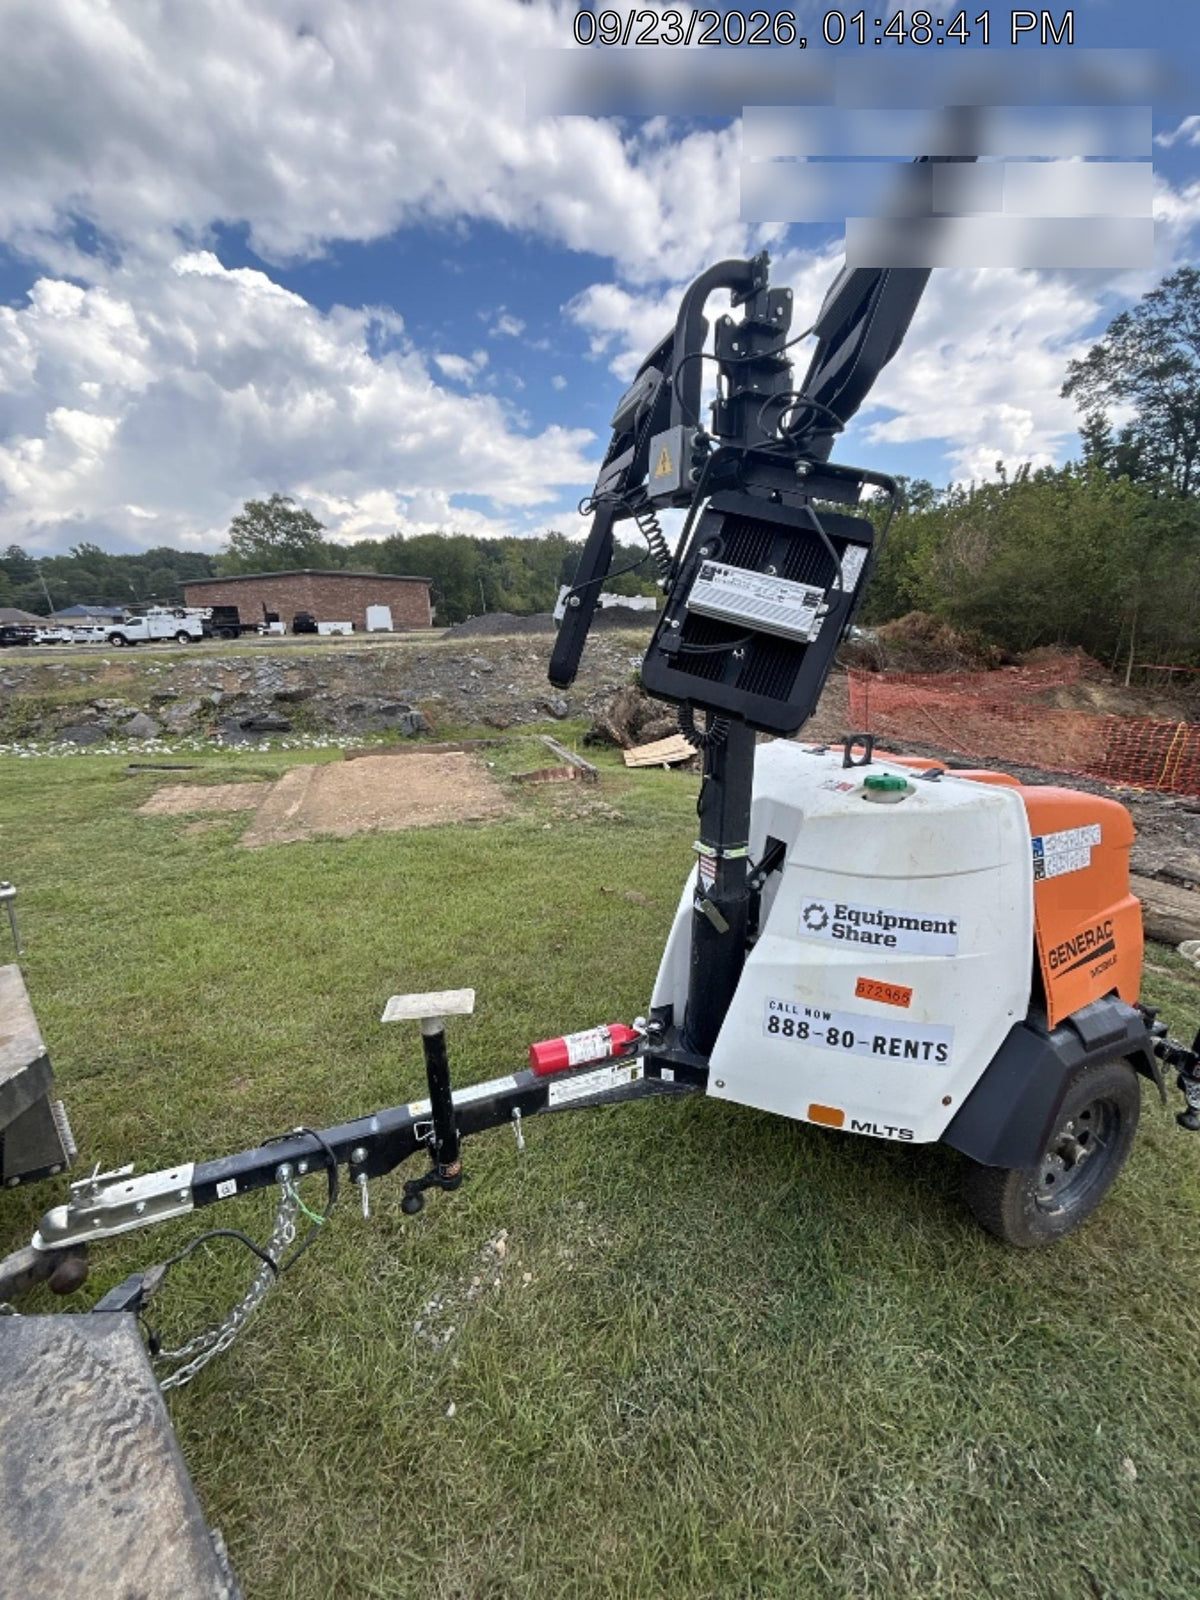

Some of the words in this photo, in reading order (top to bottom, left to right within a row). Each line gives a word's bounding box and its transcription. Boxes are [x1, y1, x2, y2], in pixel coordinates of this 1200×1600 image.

[834, 904, 957, 935] Equipment
[832, 924, 897, 947] Share
[1049, 920, 1113, 970] GENERAC
[769, 1001, 799, 1015] CALL
[805, 1008, 832, 1021] NOW
[768, 1016, 948, 1062] 888-80-RENTS
[851, 1119, 914, 1140] MLTS
